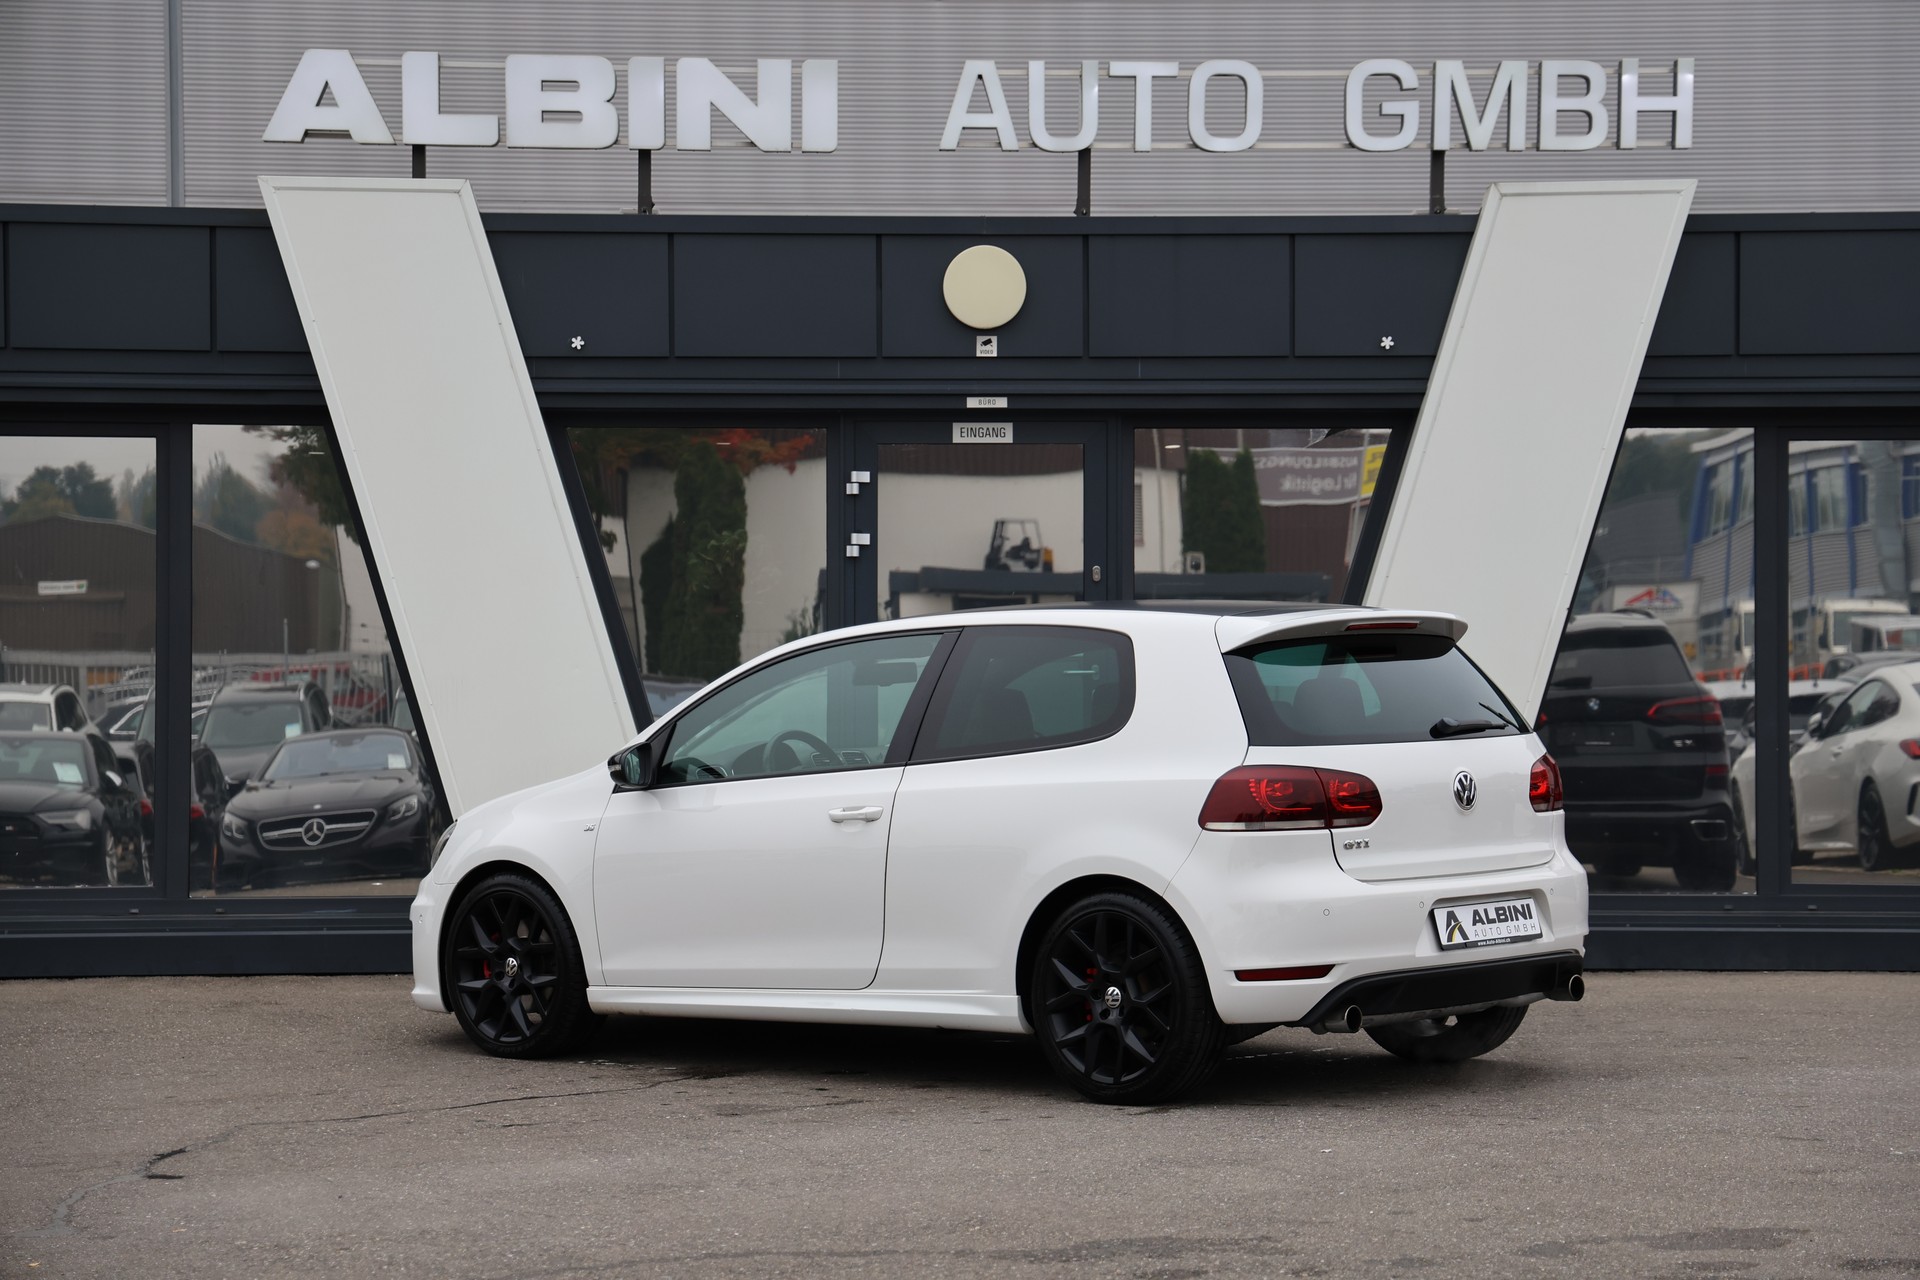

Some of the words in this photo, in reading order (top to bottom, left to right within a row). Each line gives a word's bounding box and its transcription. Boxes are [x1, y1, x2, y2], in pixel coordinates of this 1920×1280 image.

[263, 48, 838, 153] ALBINI
[939, 59, 1264, 153] AUTO
[1345, 57, 1695, 152] GMBH
[978, 398, 997, 406] BÜRO
[960, 427, 1006, 438] EINGANG
[1343, 839, 1370, 850] GTI
[1472, 903, 1533, 926] ALBINI
[1474, 926, 1502, 938] AUTO
[1506, 923, 1537, 935] GMBH
